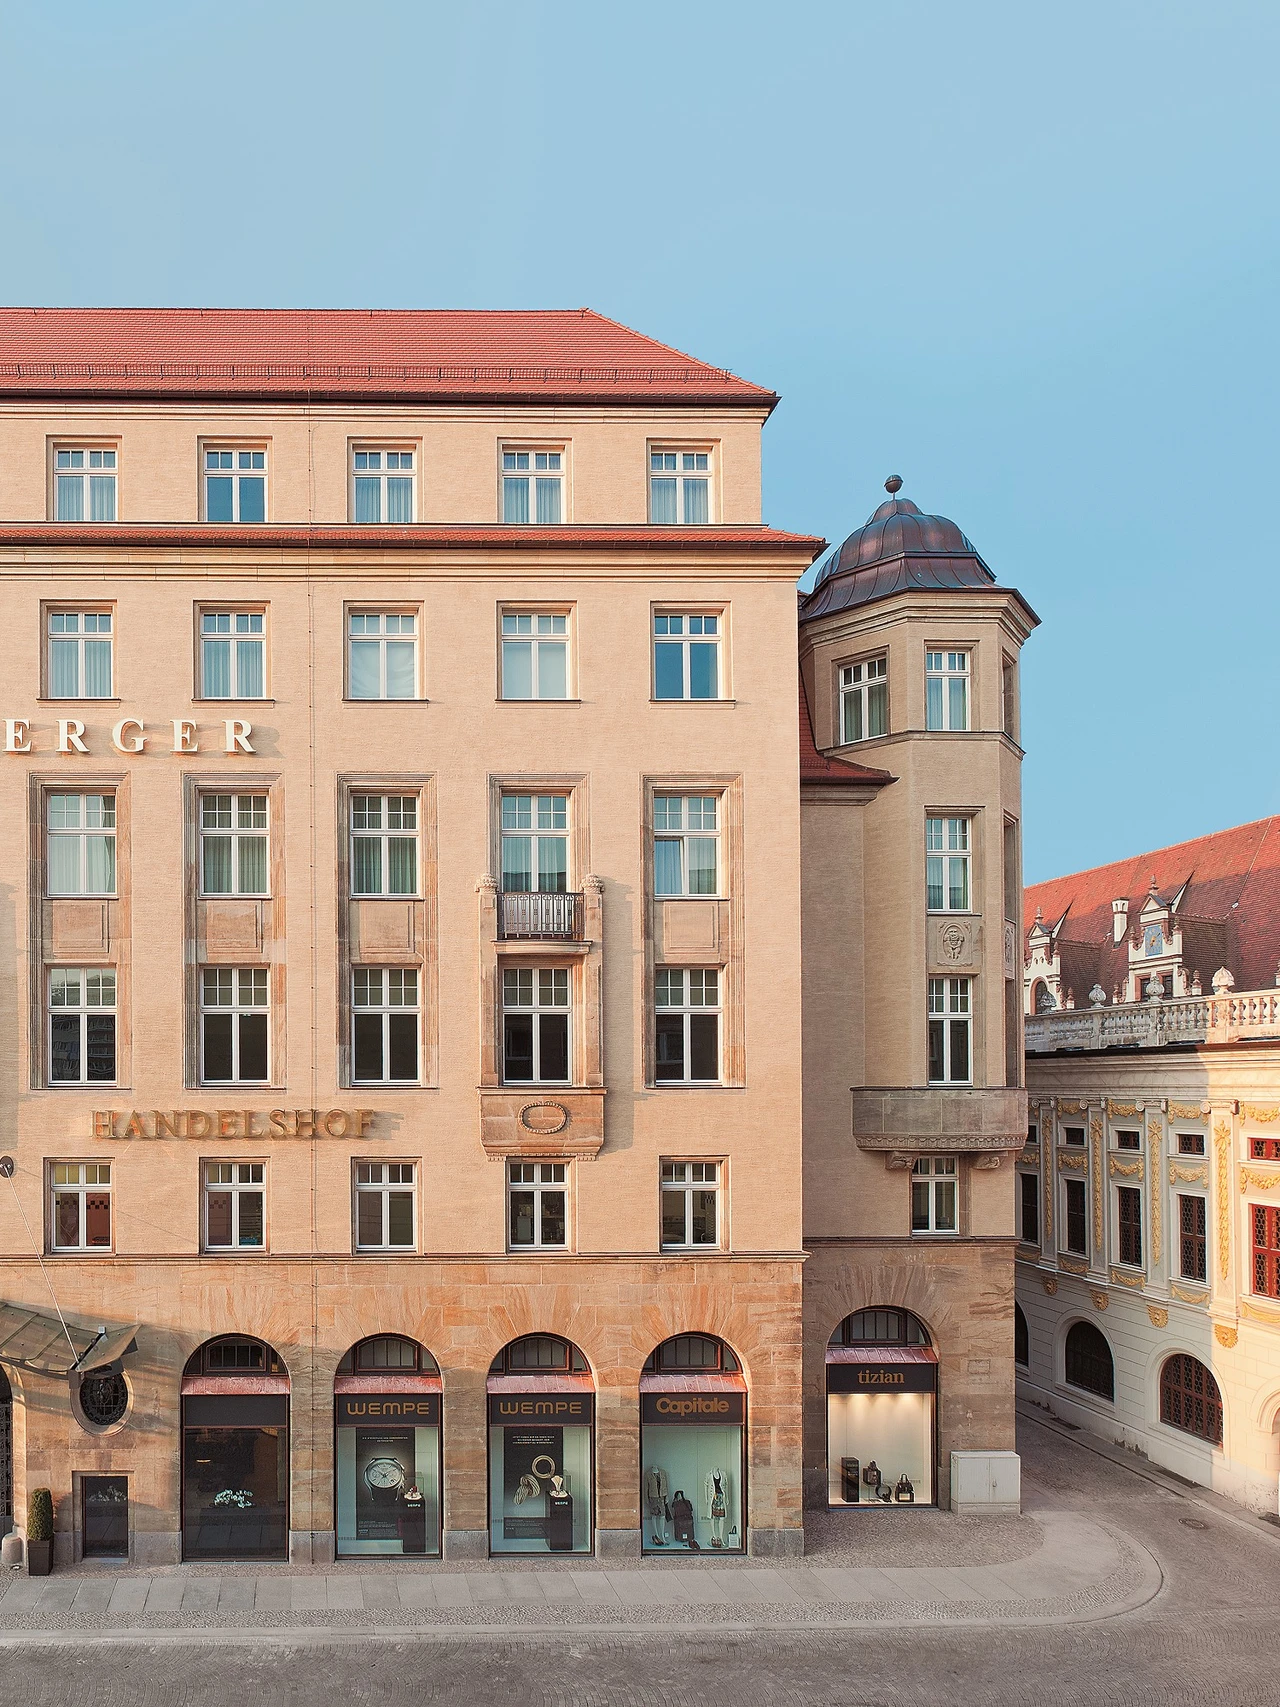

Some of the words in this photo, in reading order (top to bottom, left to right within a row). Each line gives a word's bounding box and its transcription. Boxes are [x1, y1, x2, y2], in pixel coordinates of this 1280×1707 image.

[89, 1108, 375, 1139] HANDELSHOF
[857, 1369, 905, 1384] tizian
[347, 1402, 430, 1415] WEMPE
[500, 1401, 582, 1415] WEMPE
[656, 1397, 730, 1417] Capitale
